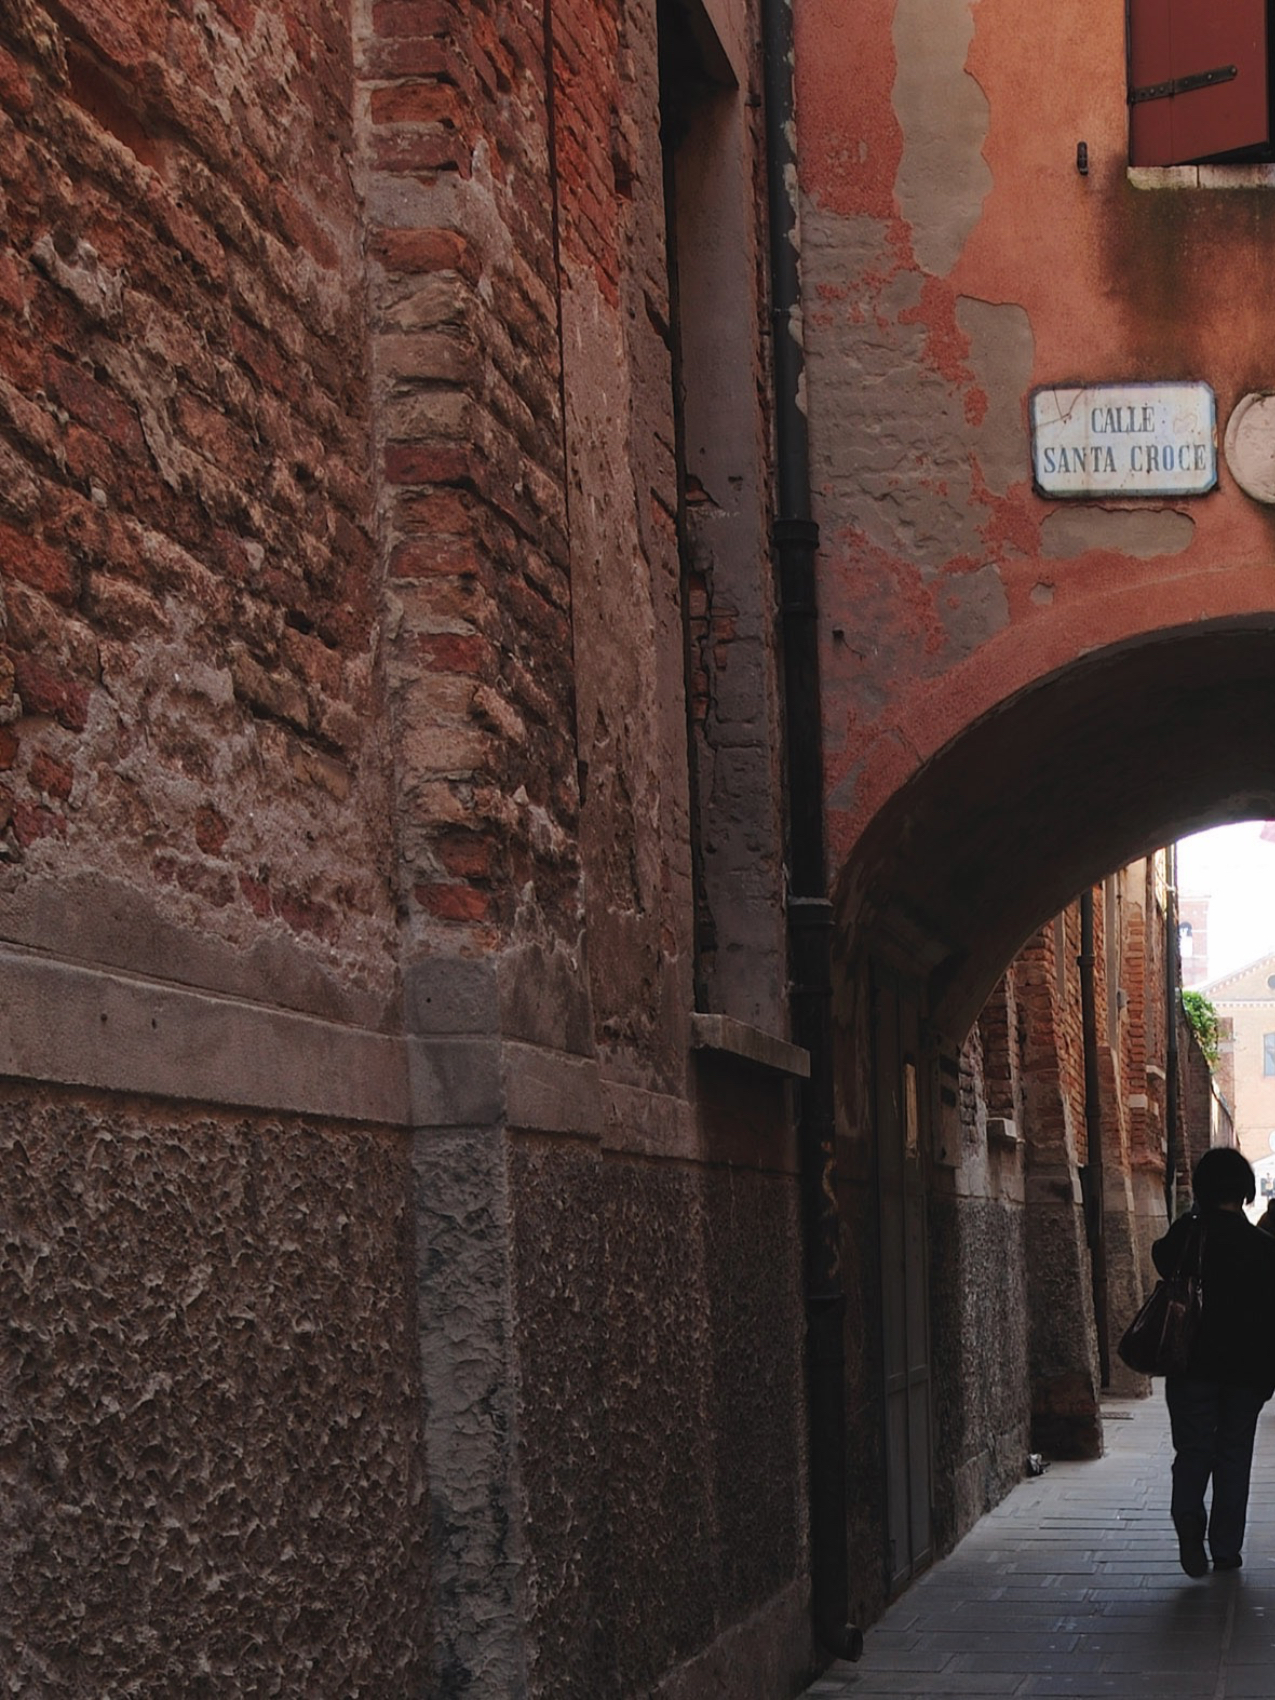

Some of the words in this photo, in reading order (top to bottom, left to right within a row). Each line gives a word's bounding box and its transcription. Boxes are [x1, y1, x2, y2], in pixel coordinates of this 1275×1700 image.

[1091, 406, 1155, 433] CALLE
[1043, 446, 1117, 474] SANTA
[1130, 444, 1207, 473] CROCE
